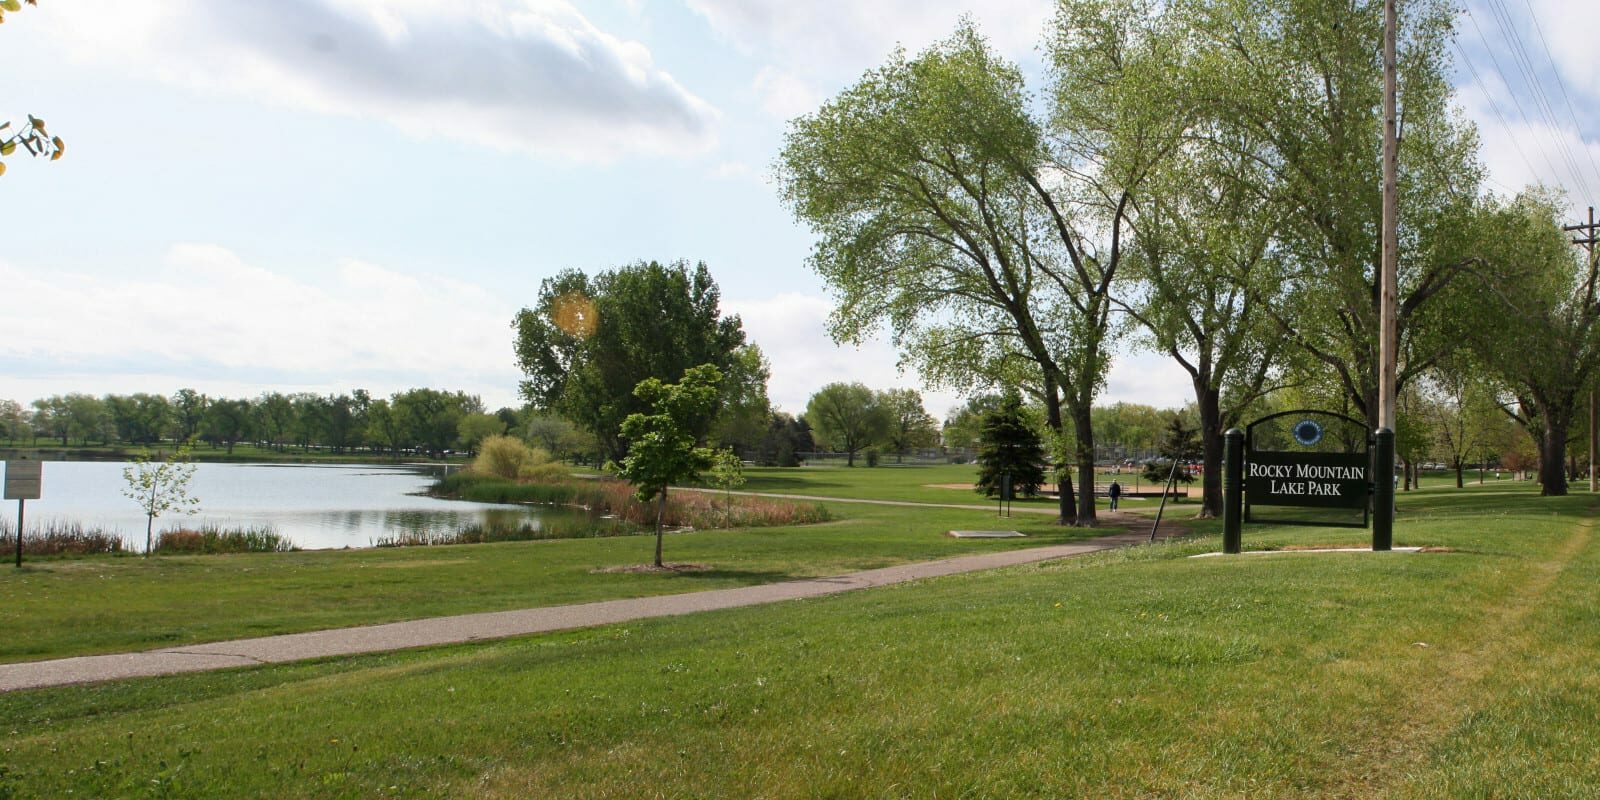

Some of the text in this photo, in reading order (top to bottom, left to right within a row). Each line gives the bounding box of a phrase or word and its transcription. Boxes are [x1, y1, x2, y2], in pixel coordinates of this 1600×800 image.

[1250, 463, 1364, 479] ROCKY MOUNTAIN
[1270, 480, 1341, 496] LAKE PARK
